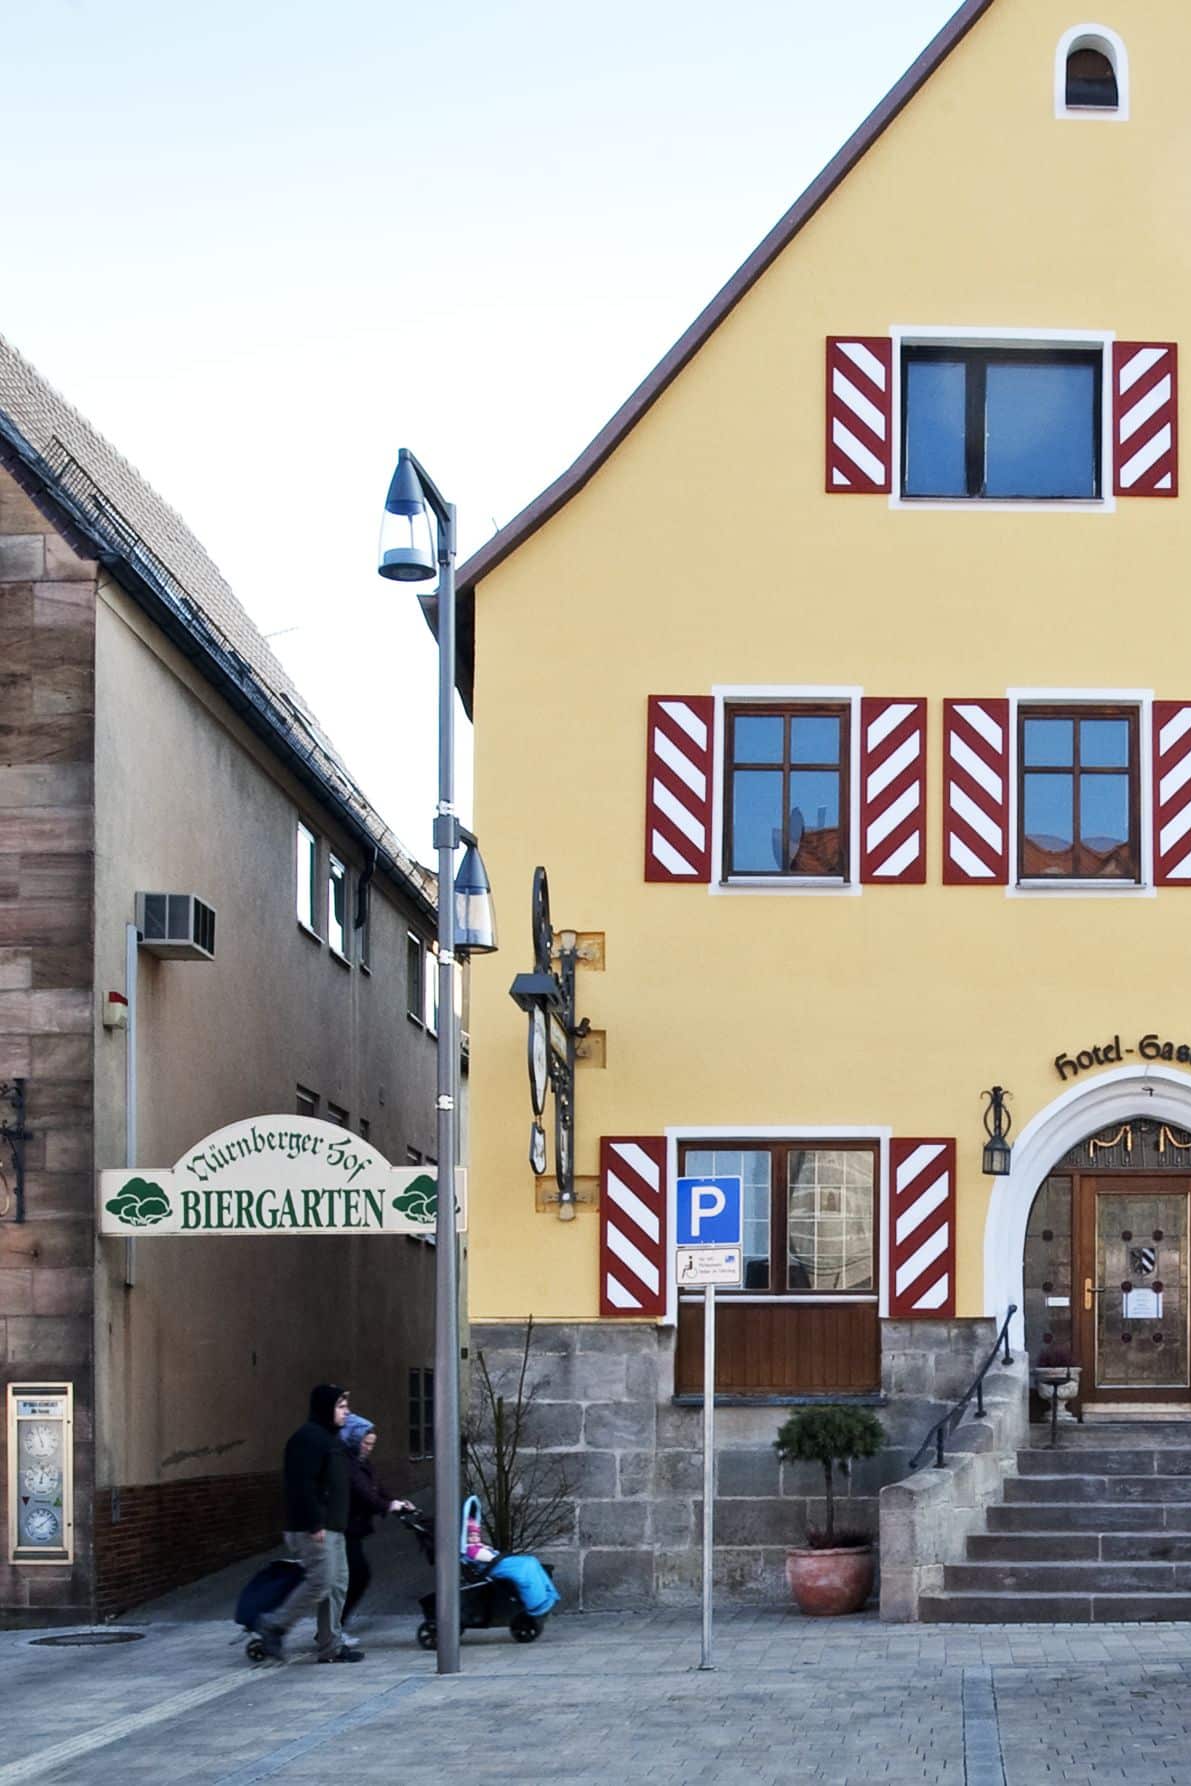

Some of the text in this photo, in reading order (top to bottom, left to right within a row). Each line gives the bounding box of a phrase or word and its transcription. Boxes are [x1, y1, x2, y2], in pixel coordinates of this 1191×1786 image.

[186, 1125, 373, 1183] Nürnberger Hof
[179, 1187, 386, 1230] BIERGARTEN
[690, 1185, 726, 1237] P
